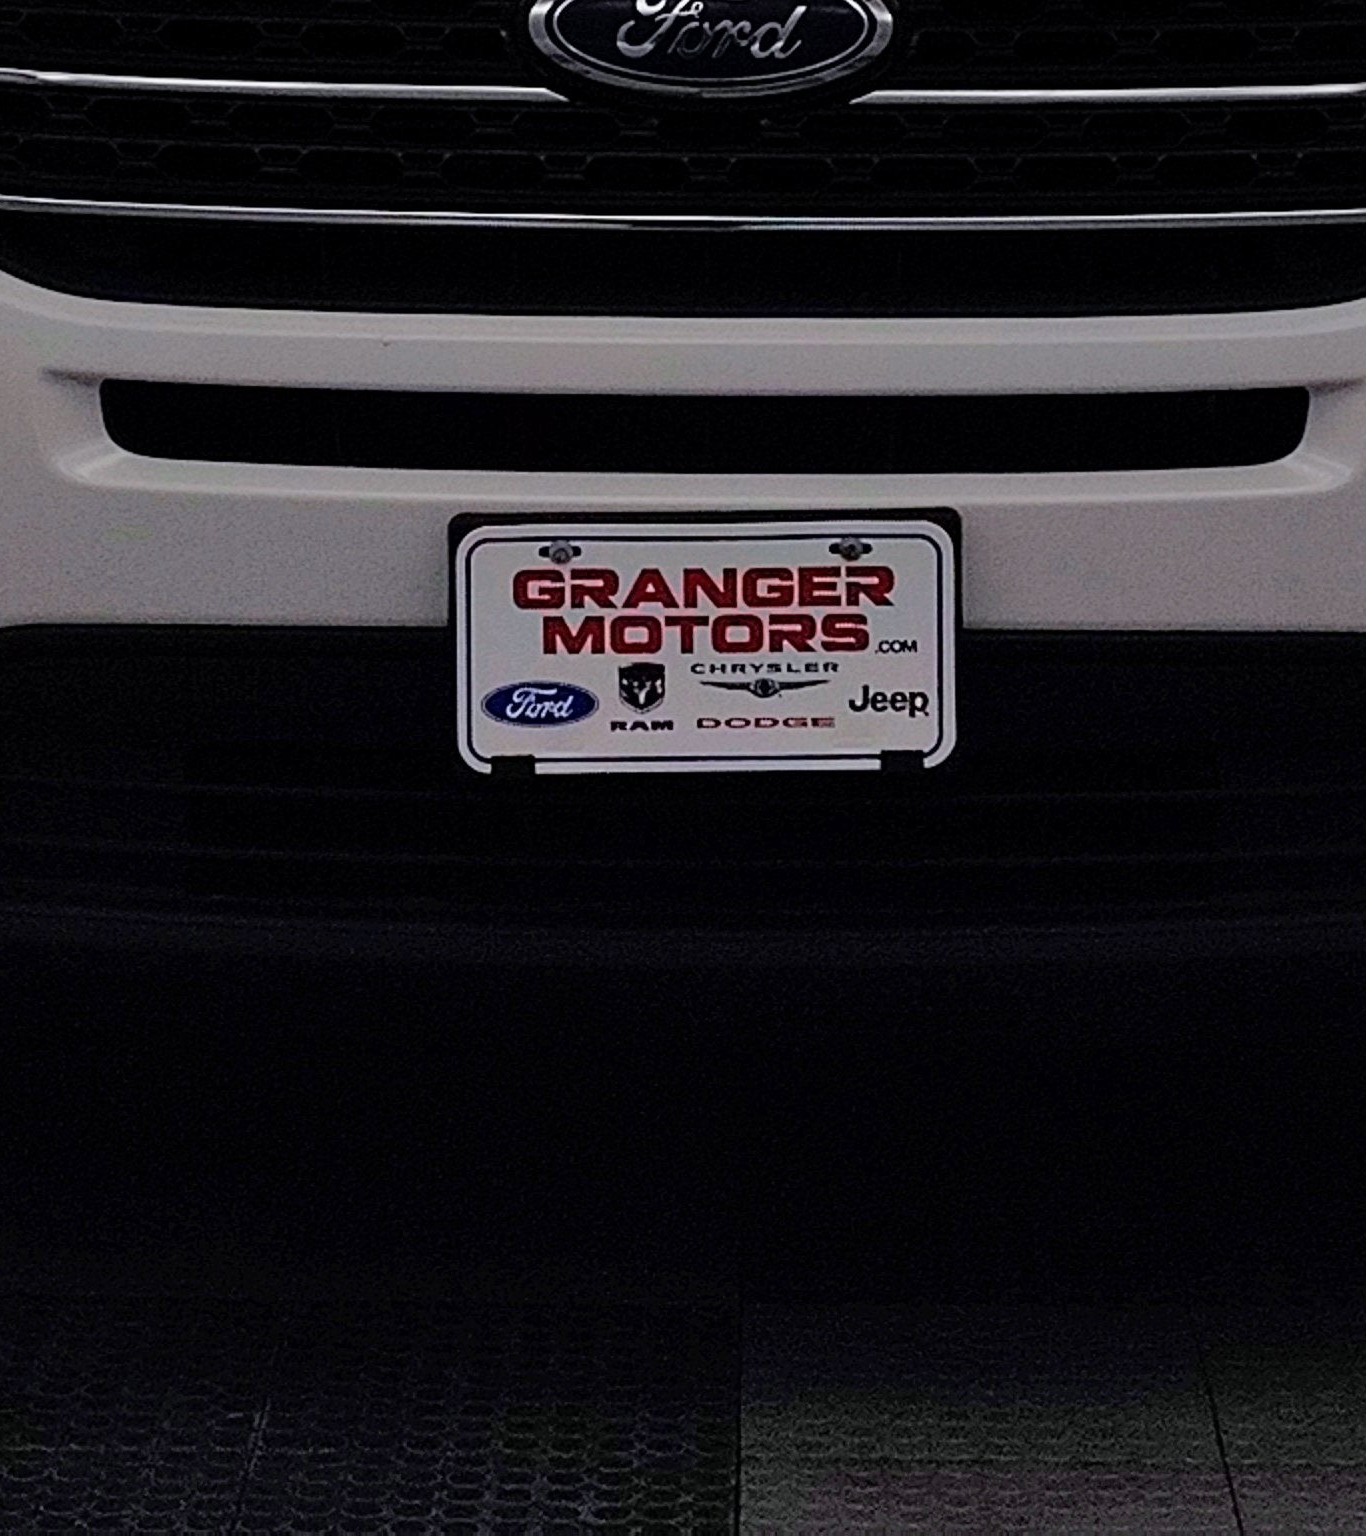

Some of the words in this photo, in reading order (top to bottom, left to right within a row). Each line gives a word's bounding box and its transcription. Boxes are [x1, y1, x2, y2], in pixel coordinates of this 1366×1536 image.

[512, 565, 895, 610] GRANGER
[543, 614, 870, 655] MOTORS
[691, 662, 839, 675] CHRYSLER
[506, 689, 573, 719] Ford
[848, 685, 929, 717] Jeep
[611, 721, 674, 731] RAM
[697, 718, 835, 729] DODGE
